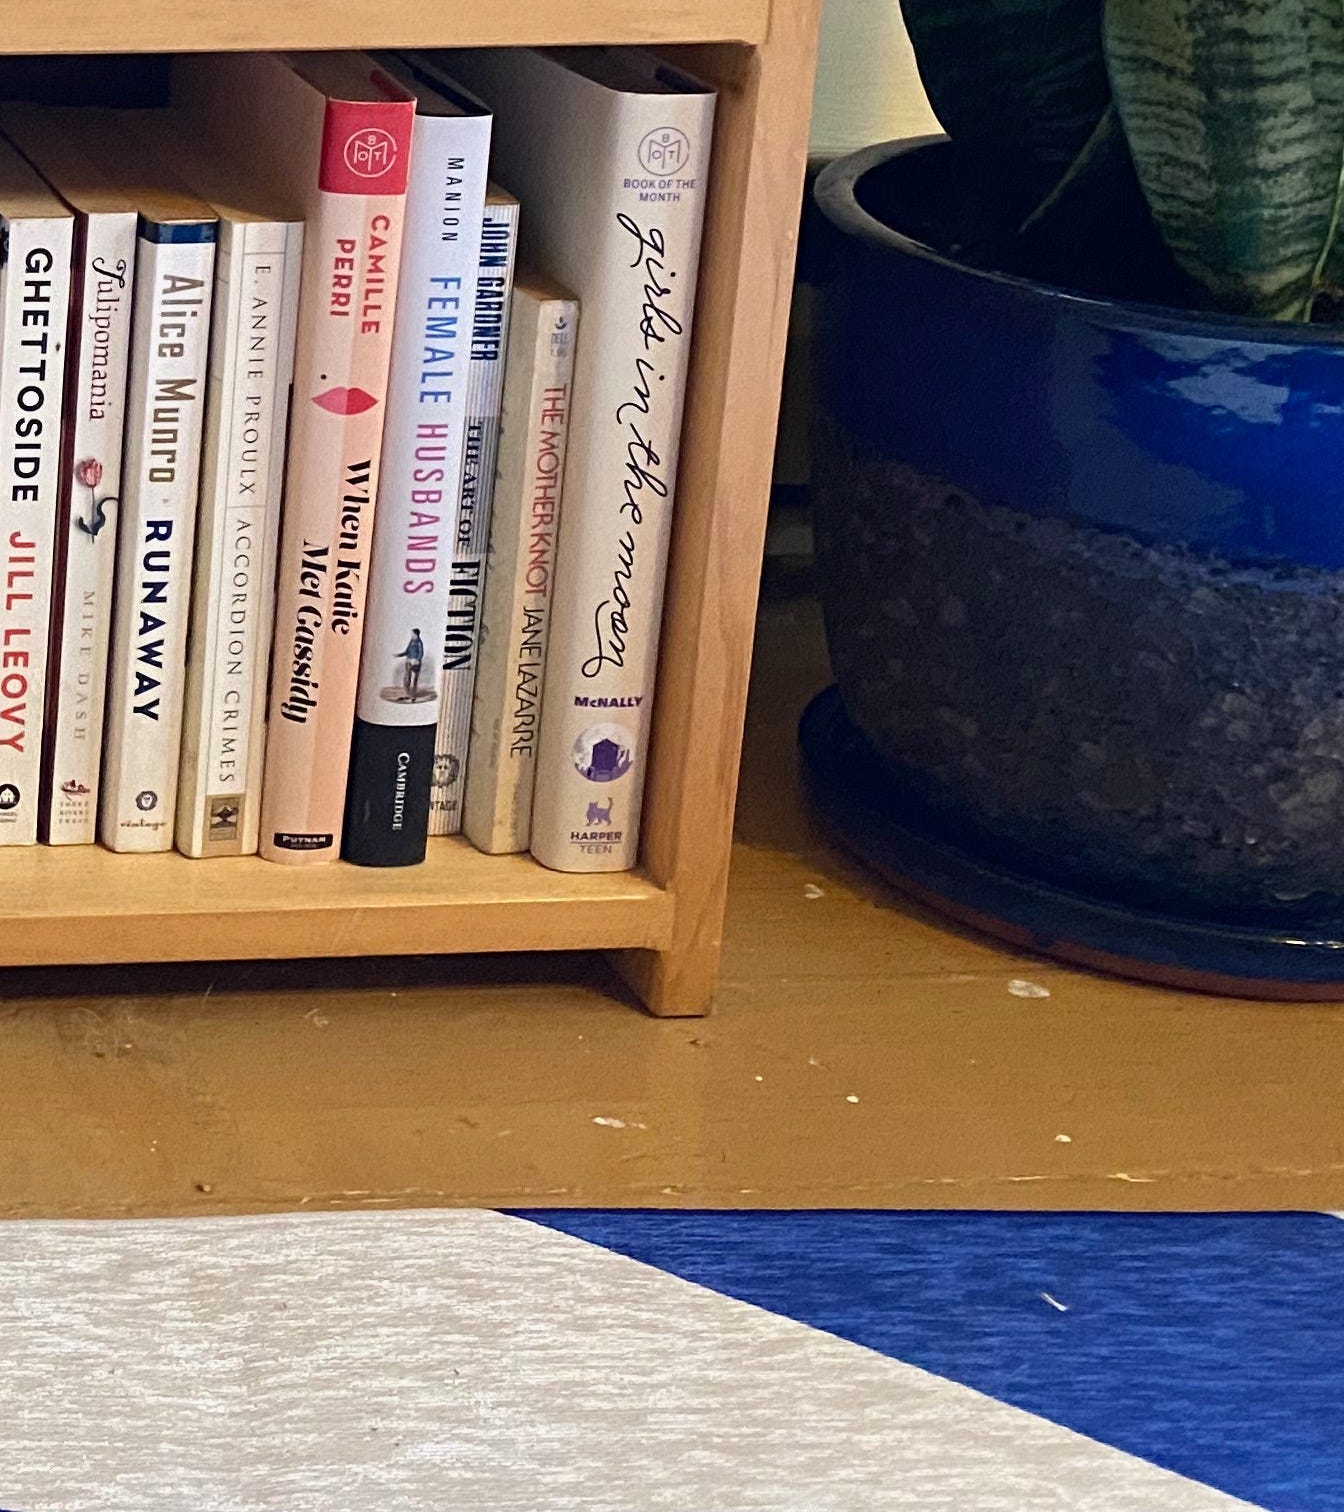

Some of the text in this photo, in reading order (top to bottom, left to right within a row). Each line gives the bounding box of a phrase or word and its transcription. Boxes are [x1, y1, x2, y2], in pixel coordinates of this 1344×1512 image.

[442, 157, 464, 243] MANION
[639, 192, 680, 202] MONTH
[11, 247, 53, 502] GHETTOSIDE
[148, 274, 204, 482] Alice Munro
[238, 265, 270, 496] E. ANNIE PROULX
[402, 276, 461, 595] FEMALE HUSBANDS
[74, 590, 95, 741] MIKE DASH
[132, 520, 173, 721] RUNAWAY
[509, 606, 544, 758] JANE LAZARRE
[570, 831, 622, 841] HARPER
